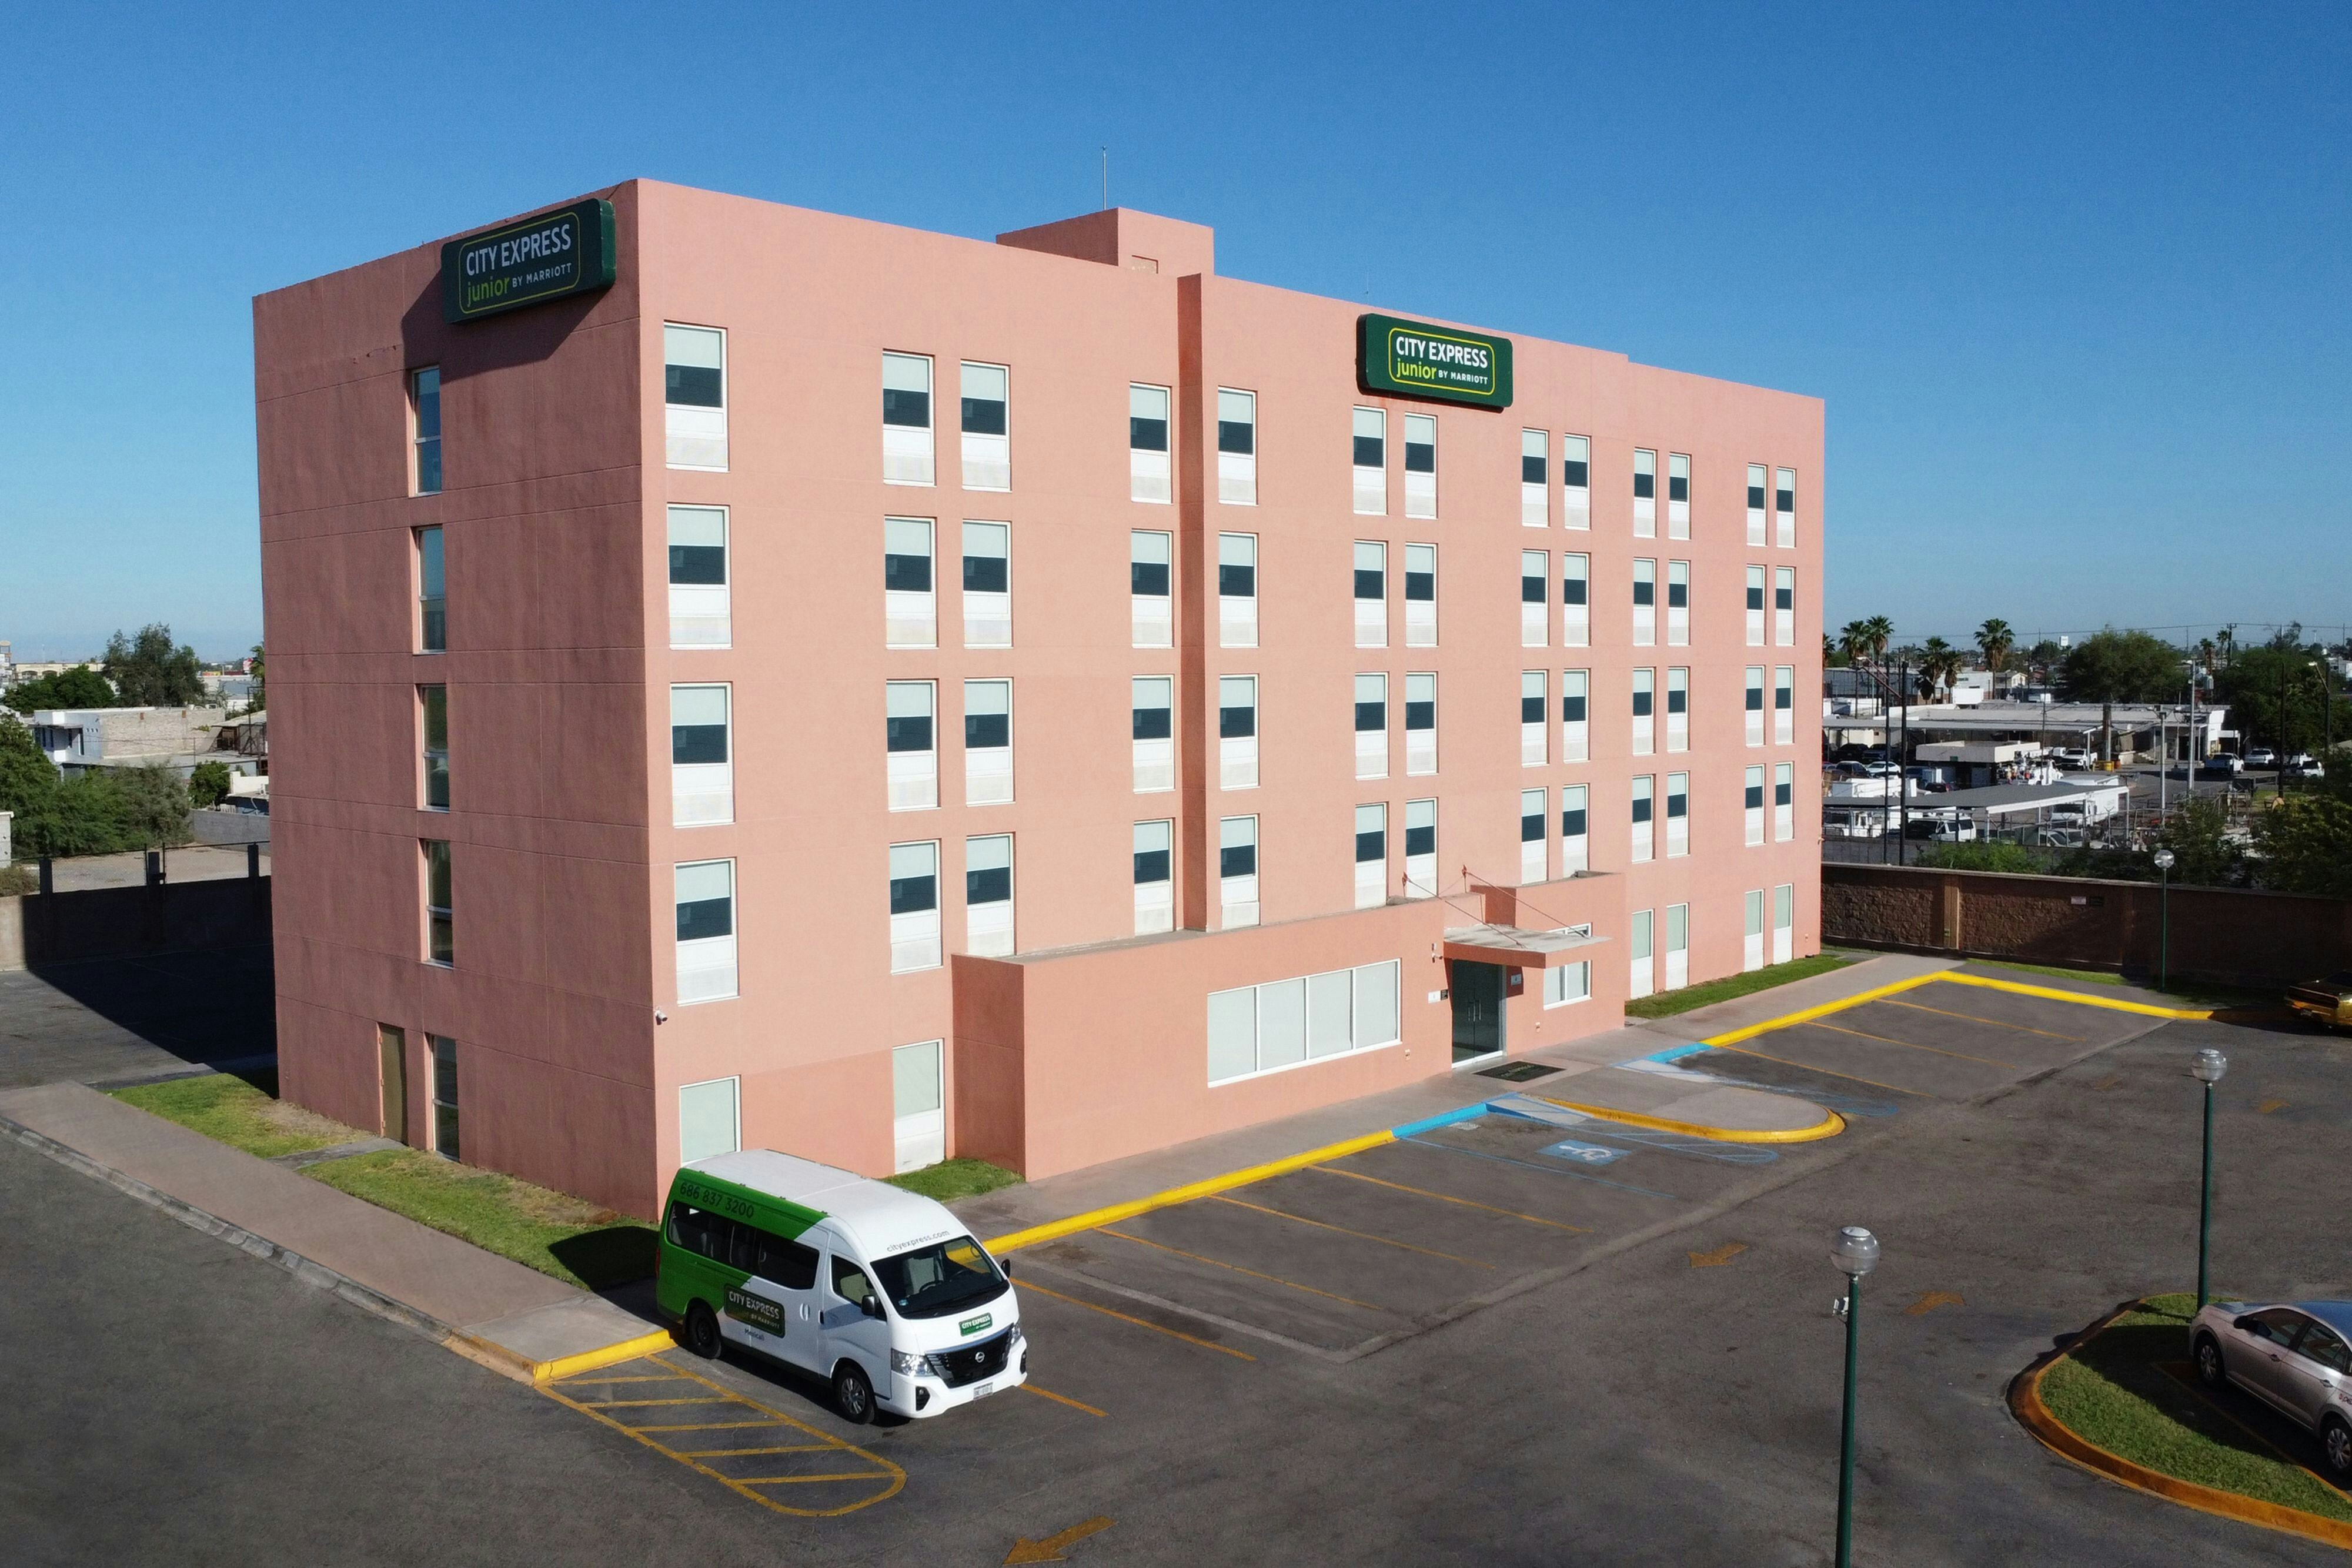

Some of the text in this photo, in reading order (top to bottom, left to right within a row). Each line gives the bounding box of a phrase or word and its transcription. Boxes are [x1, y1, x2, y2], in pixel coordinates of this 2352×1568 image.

[466, 224, 571, 276] CITY EXPRESS
[467, 263, 572, 307] junior BY MARRIOTT
[1396, 336, 1488, 369] CITY EXPRESS
[1396, 357, 1488, 385] junior BY MARRIOTT
[680, 1182, 754, 1218] 686 837 3200
[887, 1231, 950, 1252] cityexpress.com
[729, 1291, 779, 1319] CITY EXPRESS
[972, 1315, 990, 1326] EXPRESS
